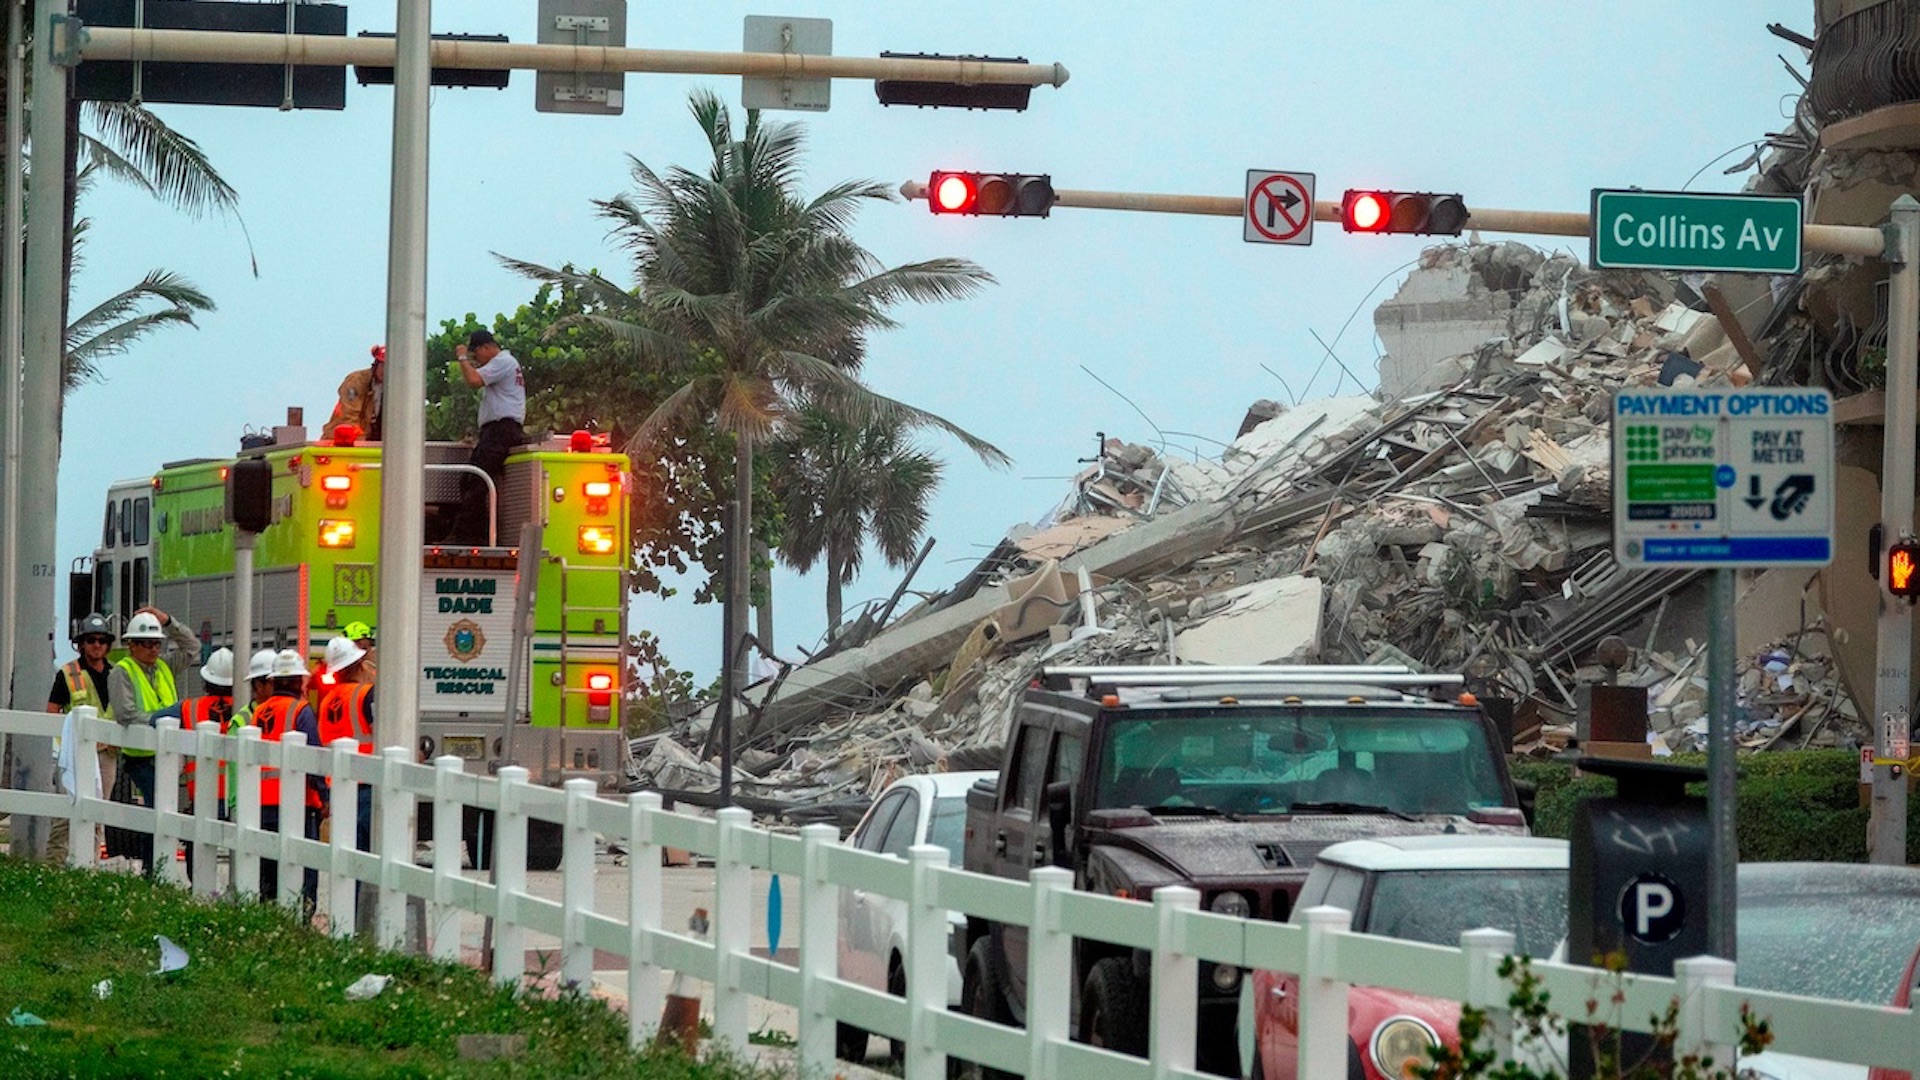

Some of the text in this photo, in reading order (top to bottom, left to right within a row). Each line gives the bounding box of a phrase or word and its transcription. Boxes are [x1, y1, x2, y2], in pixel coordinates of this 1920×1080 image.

[1613, 212, 1784, 251] Collins Av
[1617, 393, 1829, 415] PAYMENT OPTIONS
[1752, 430, 1804, 446] PAY AT
[1663, 443, 1715, 462] phone
[1752, 448, 1805, 464] METER
[337, 567, 373, 601] 69
[435, 578, 497, 595] MIAMI
[438, 597, 493, 613] DADE
[424, 667, 506, 681] TECHNICAL
[436, 682, 495, 694] RESCUE
[1636, 882, 1674, 934] P
